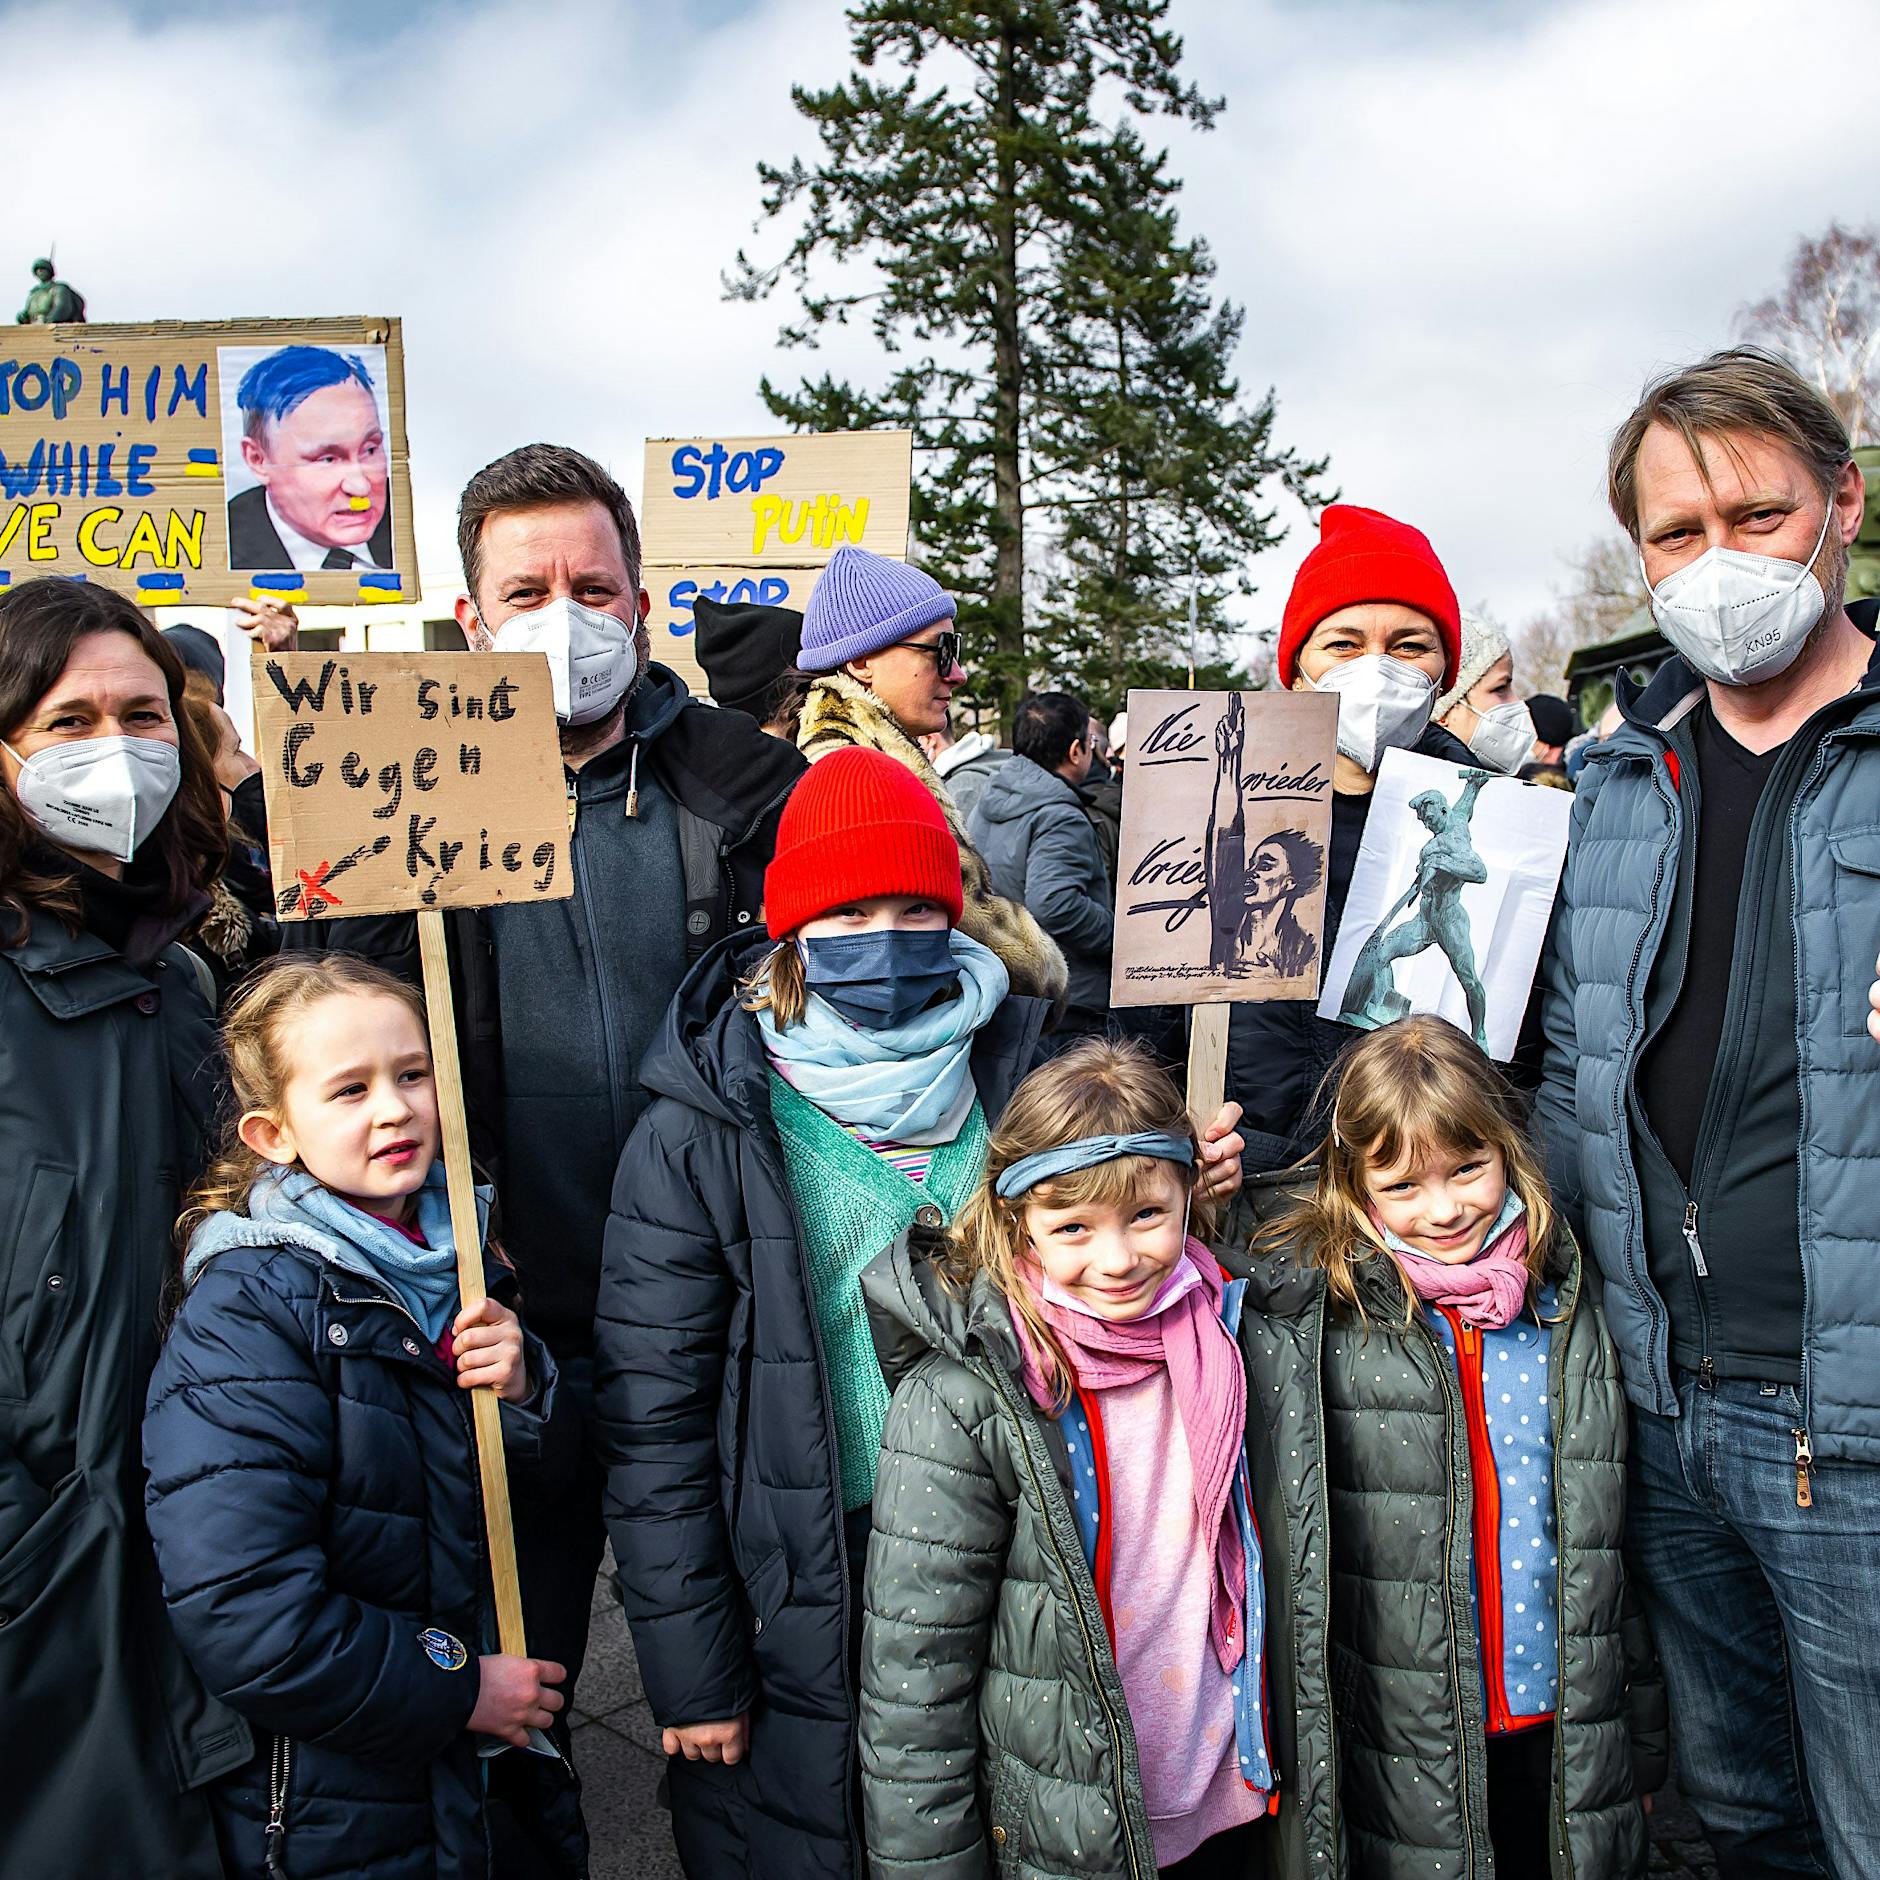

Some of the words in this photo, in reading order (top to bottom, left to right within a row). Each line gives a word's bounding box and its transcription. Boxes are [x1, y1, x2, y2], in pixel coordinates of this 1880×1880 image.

[0, 357, 82, 420] TOP
[101, 363, 207, 422] HIM
[0, 438, 158, 499] WHILE
[77, 506, 205, 569] CAN
[1745, 628, 1781, 655] KN95
[265, 659, 377, 715] Wir
[1139, 703, 1206, 754] Nie
[282, 722, 482, 819] Gegen
[1241, 762, 1332, 793] wieder
[405, 814, 556, 892] Krieg
